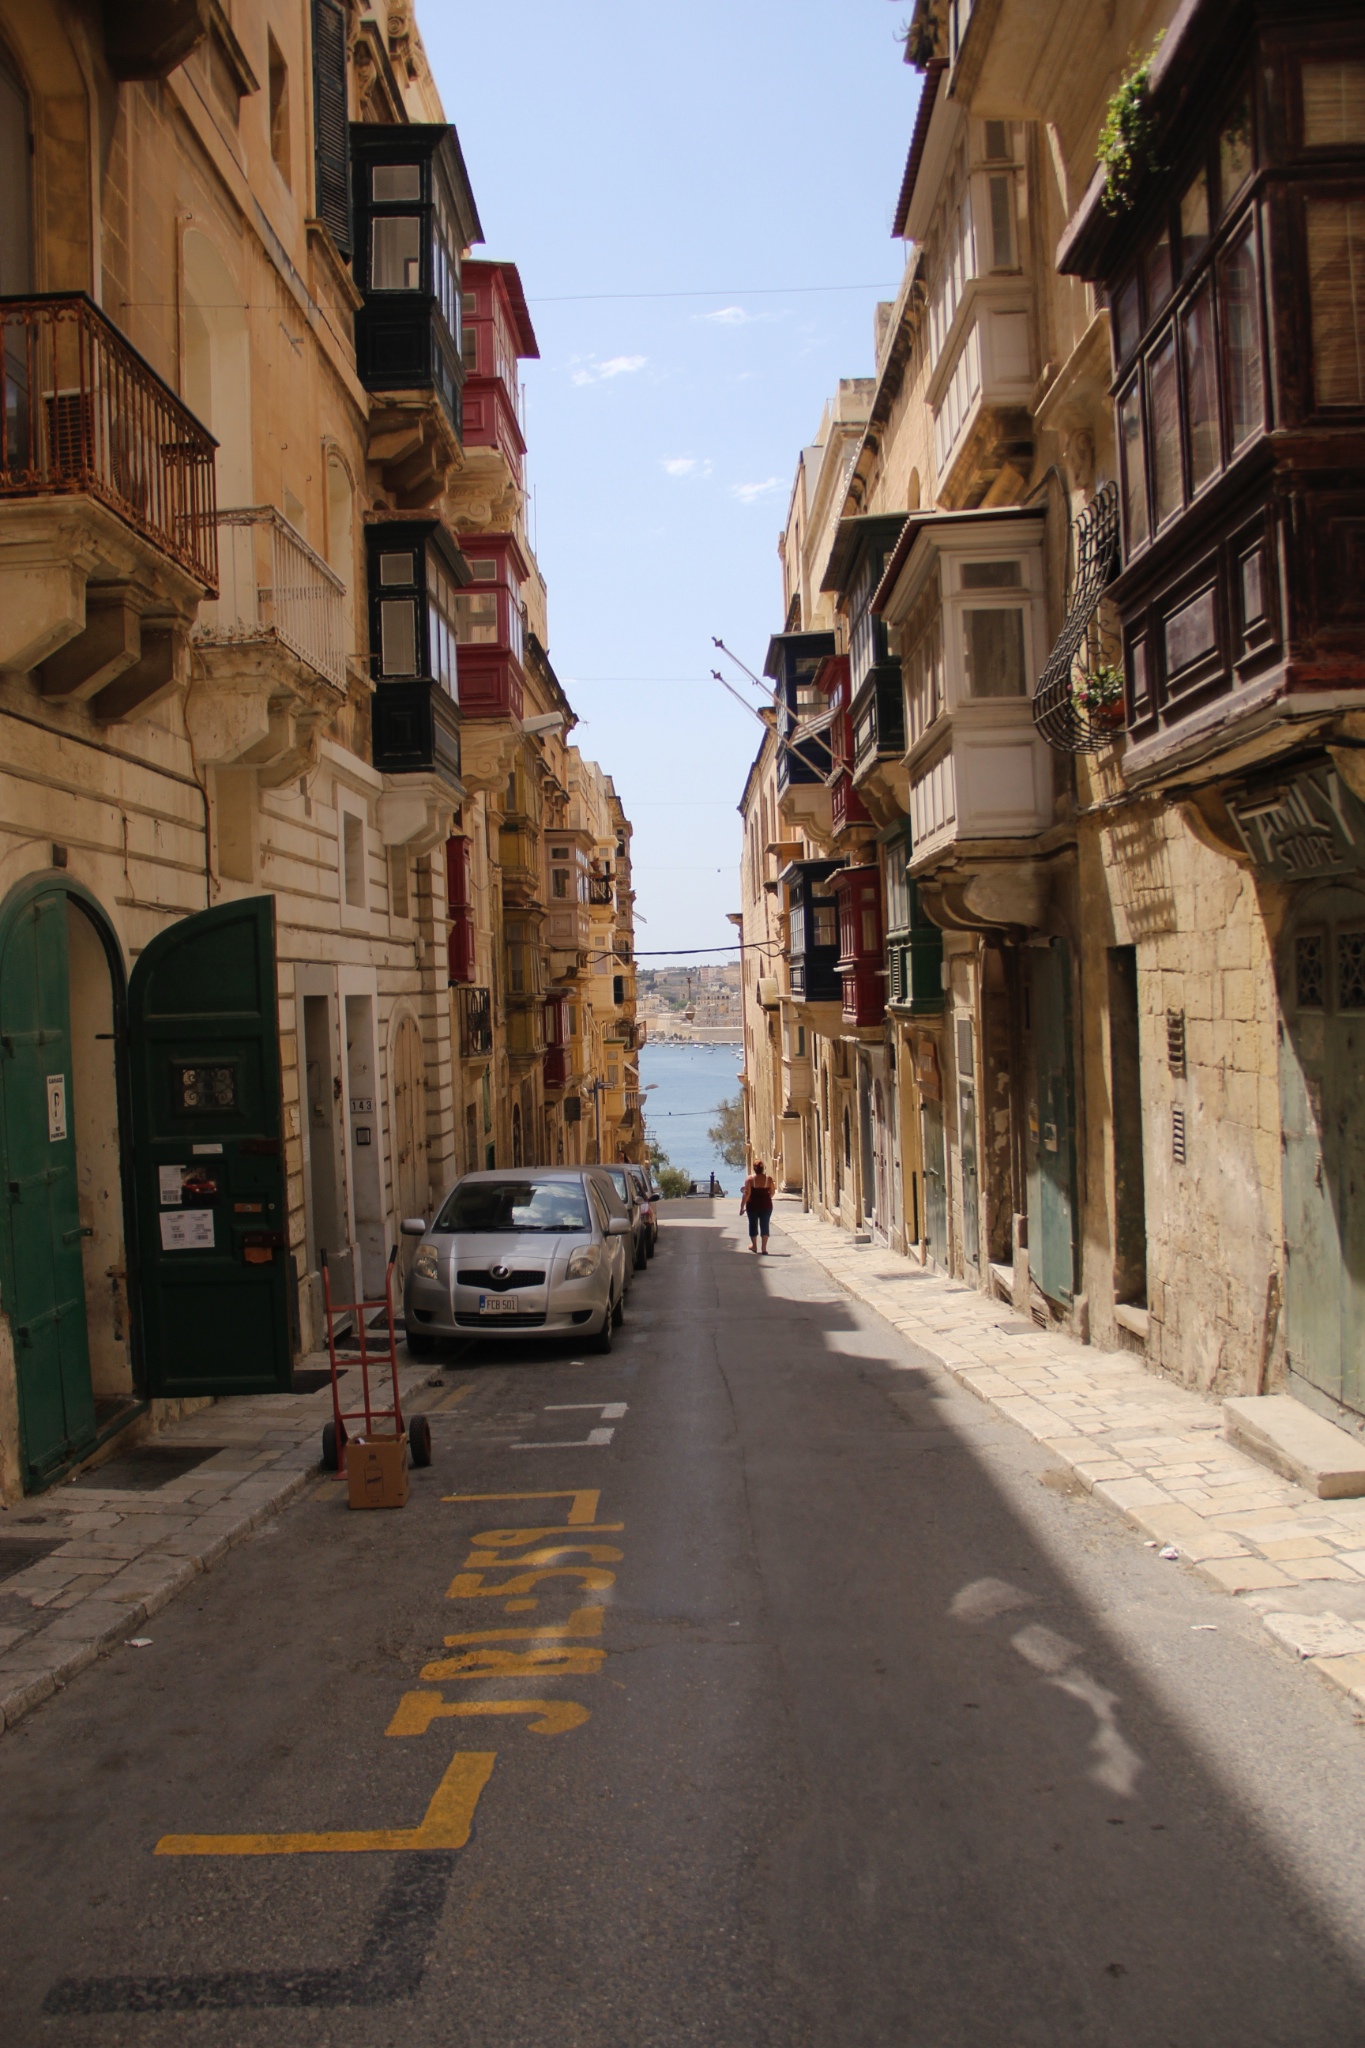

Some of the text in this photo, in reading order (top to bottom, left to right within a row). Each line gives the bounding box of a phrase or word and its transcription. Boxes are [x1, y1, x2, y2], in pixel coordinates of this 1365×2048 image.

[1225, 771, 1355, 864] FAMILY
[352, 1101, 372, 1111] 143
[50, 1131, 66, 1139] PARKING
[486, 1299, 516, 1310] FCB 501
